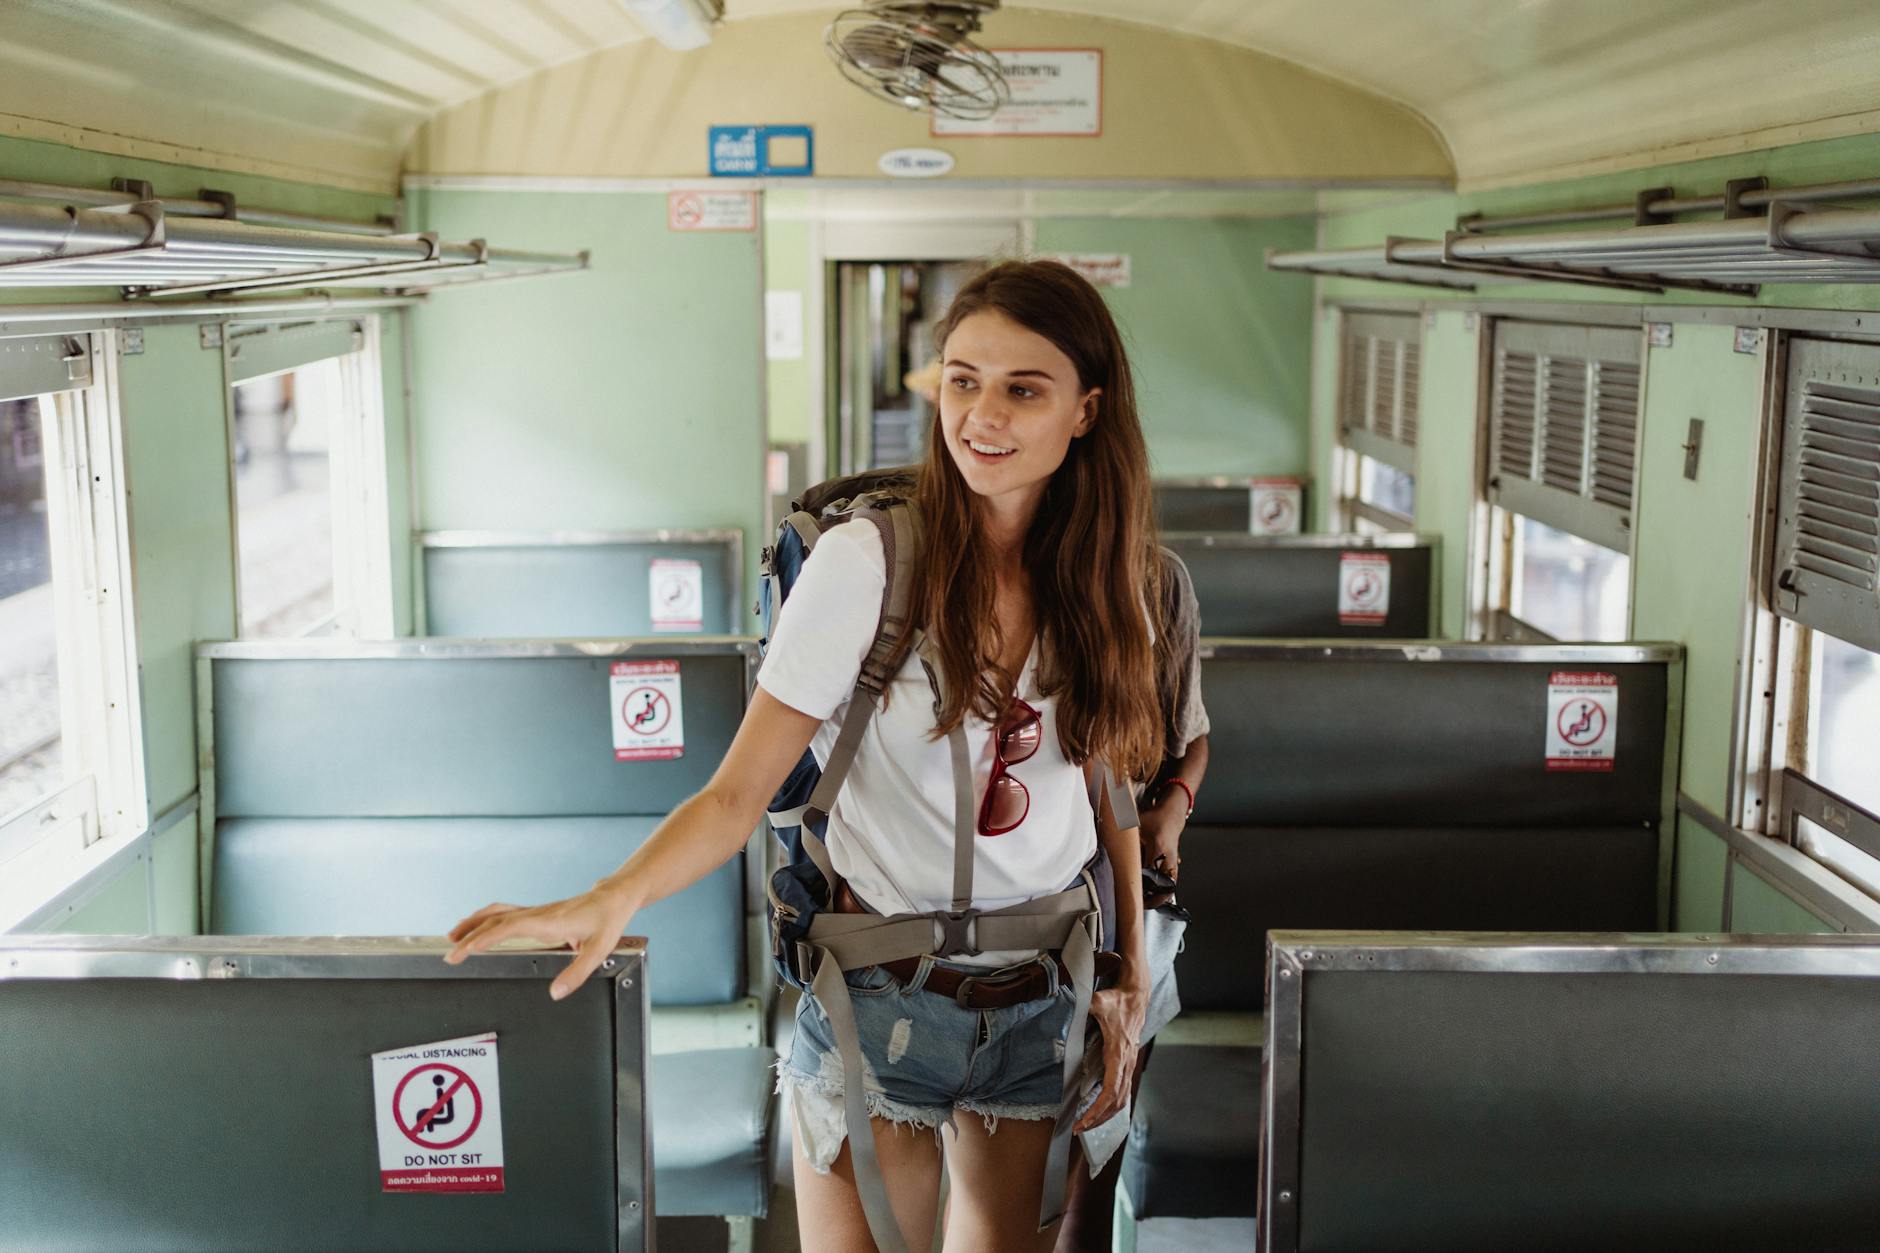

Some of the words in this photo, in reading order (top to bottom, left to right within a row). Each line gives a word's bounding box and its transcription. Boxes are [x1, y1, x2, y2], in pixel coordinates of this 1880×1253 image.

[423, 1048, 487, 1059] DISTANCING
[404, 1155, 424, 1166] DO
[429, 1154, 457, 1165] NOT
[462, 1153, 482, 1165] SIT
[460, 1174, 497, 1183] covid-19
